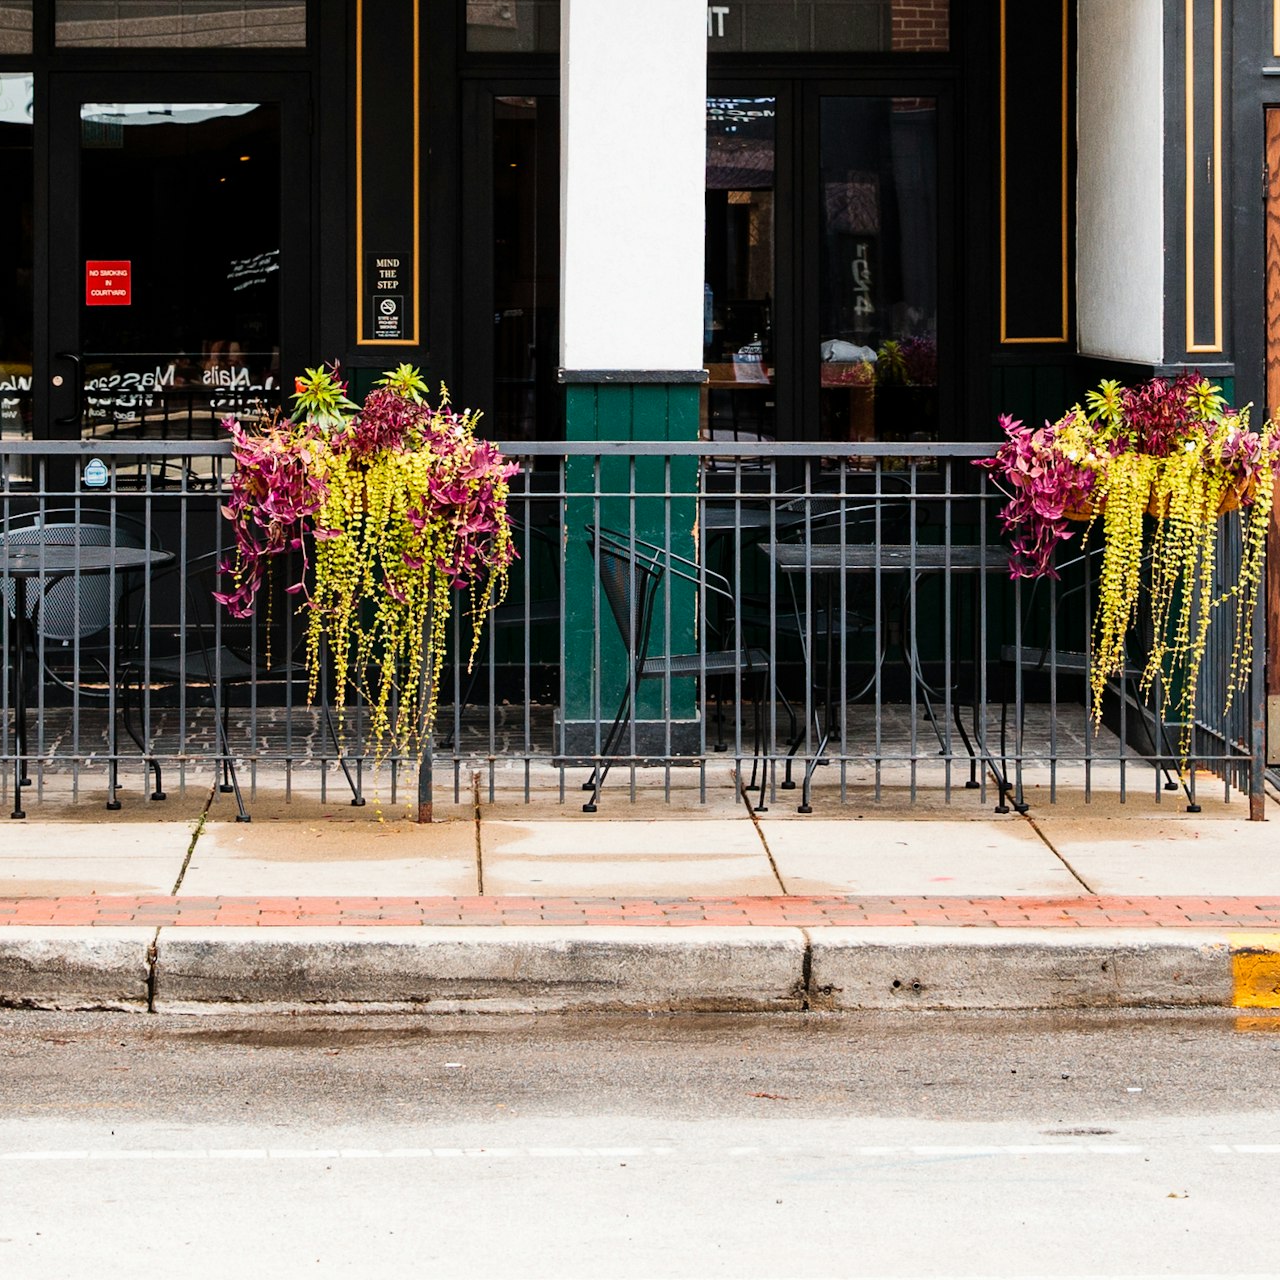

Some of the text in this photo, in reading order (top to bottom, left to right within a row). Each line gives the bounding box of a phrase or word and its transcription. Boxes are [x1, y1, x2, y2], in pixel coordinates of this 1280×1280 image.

[376, 259, 400, 267] MIND
[379, 270, 397, 278] THE
[377, 281, 399, 289] STEP
